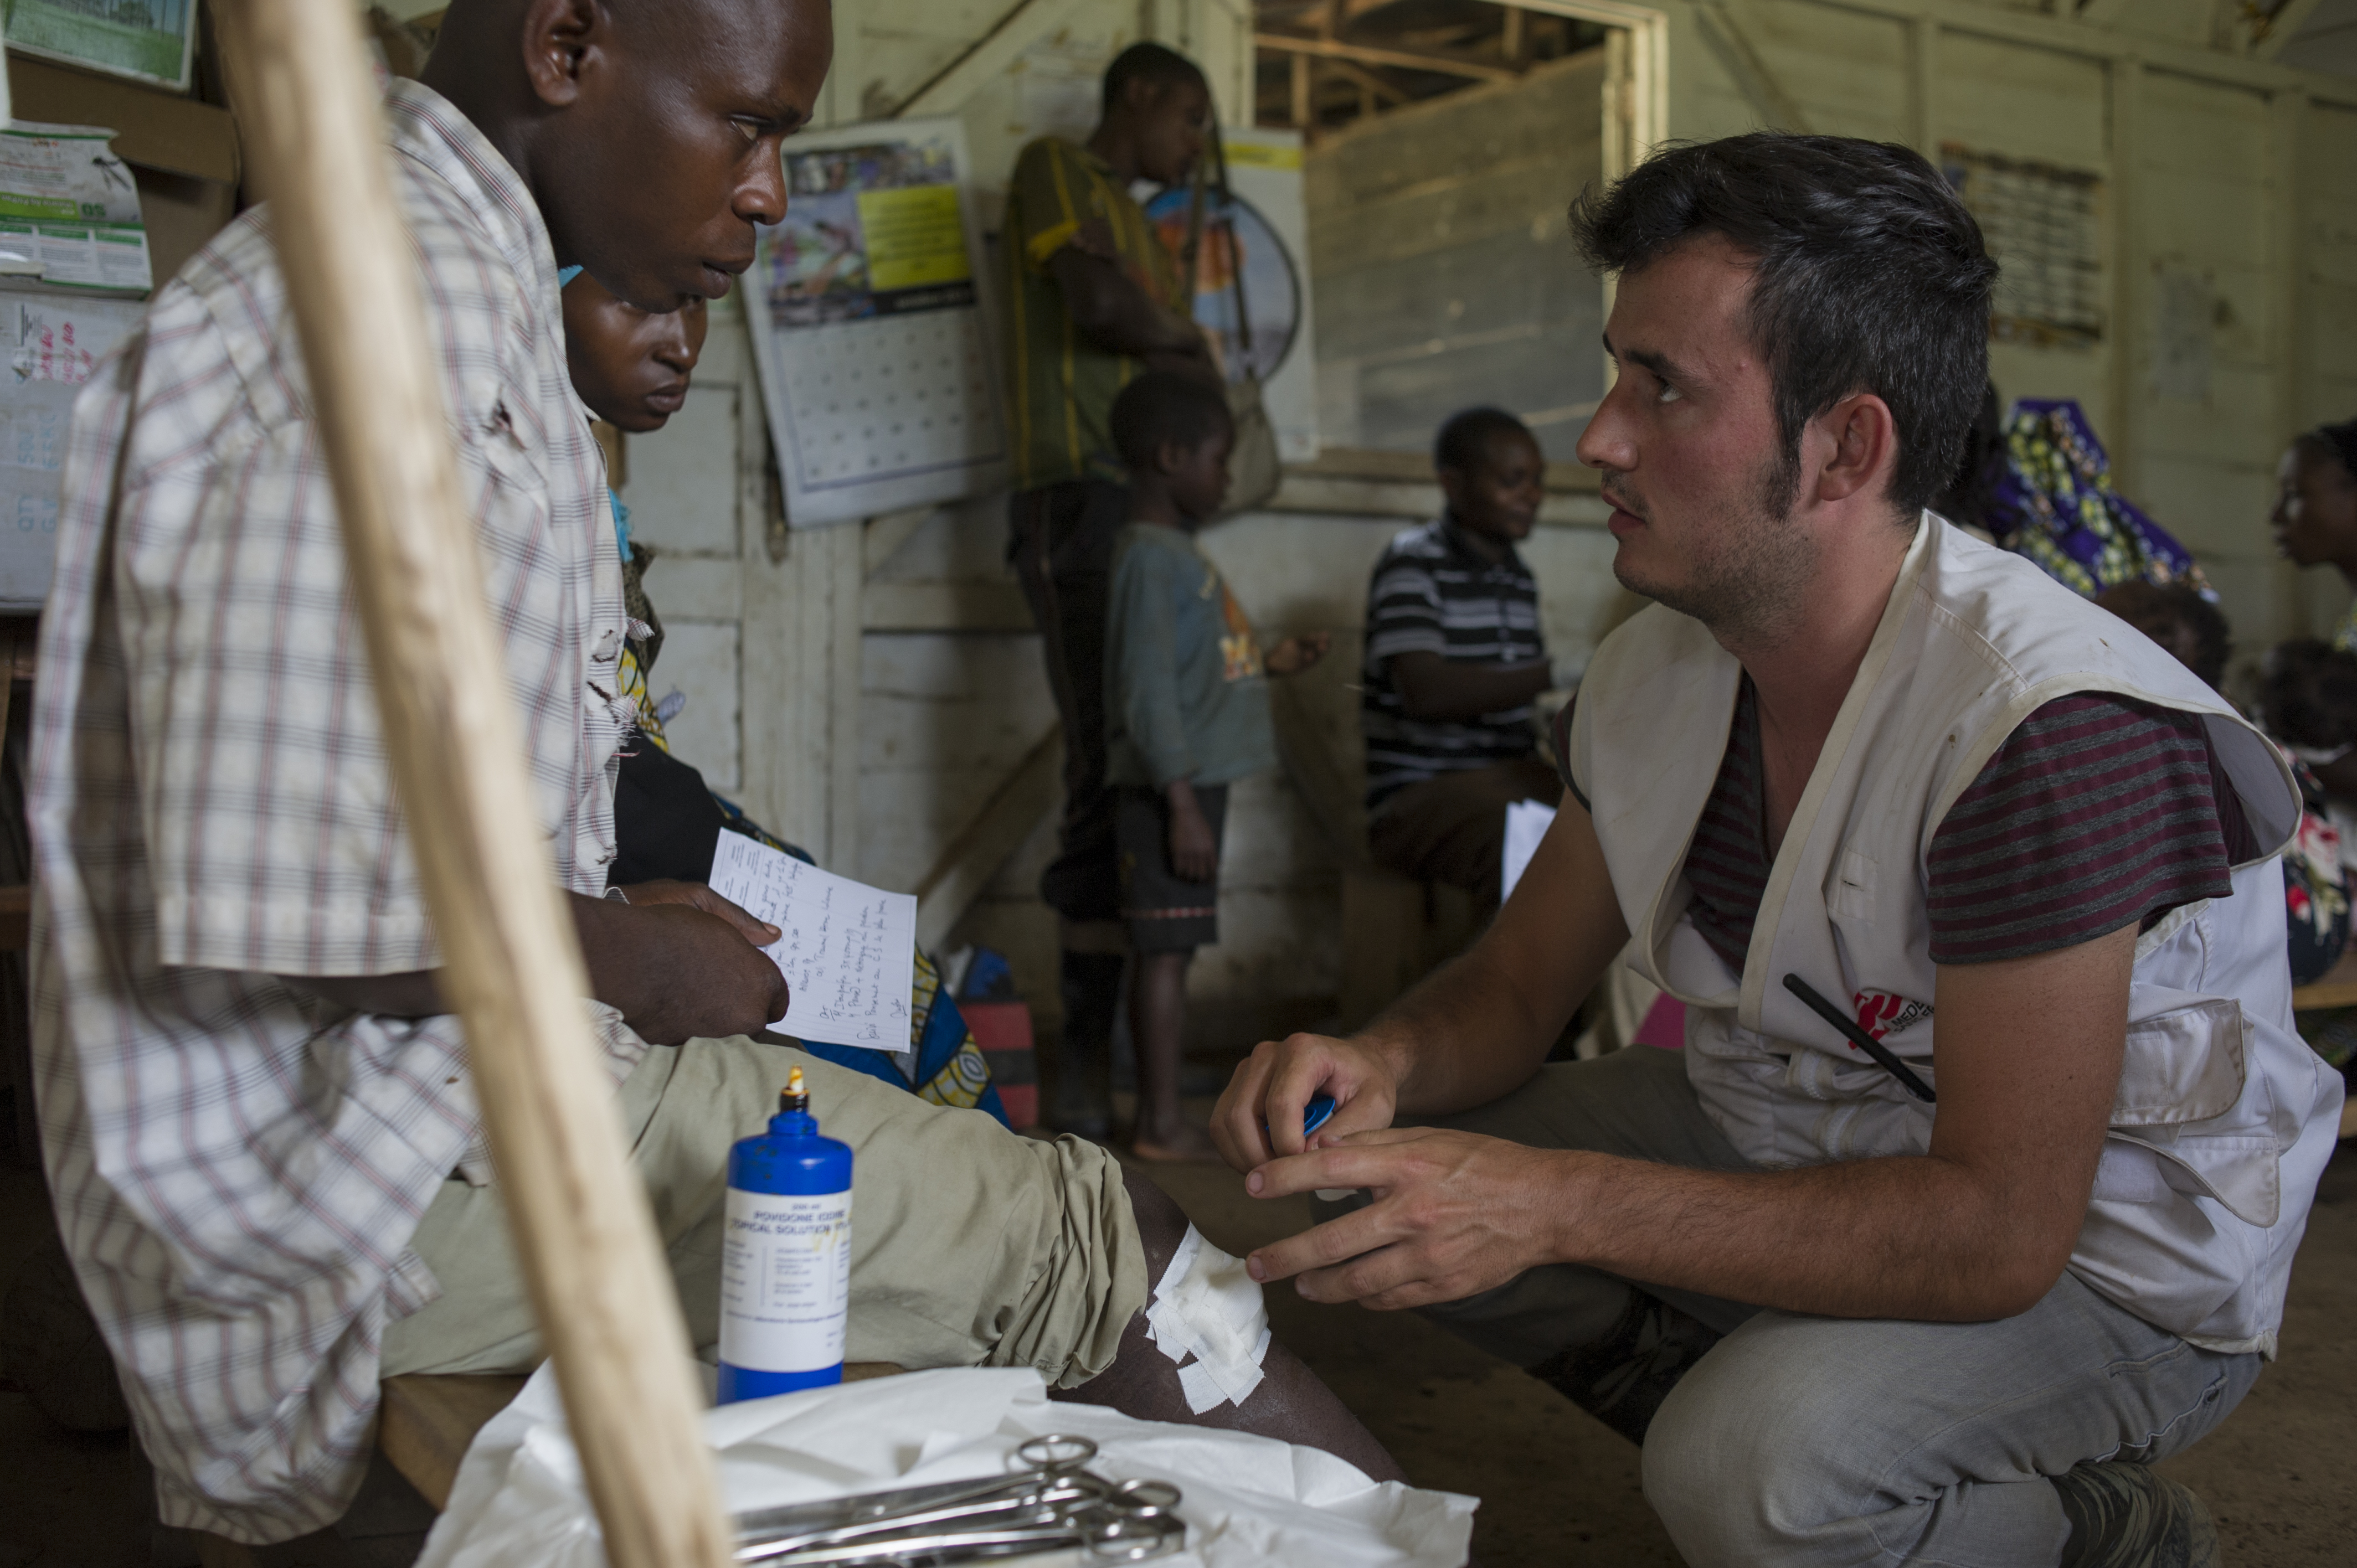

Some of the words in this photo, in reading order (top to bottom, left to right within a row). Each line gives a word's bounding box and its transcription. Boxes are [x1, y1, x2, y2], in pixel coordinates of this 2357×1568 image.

[754, 1210, 814, 1223] POVIDONE
[818, 1209, 845, 1221] IODINE
[775, 1223, 831, 1235] SOLUTION
